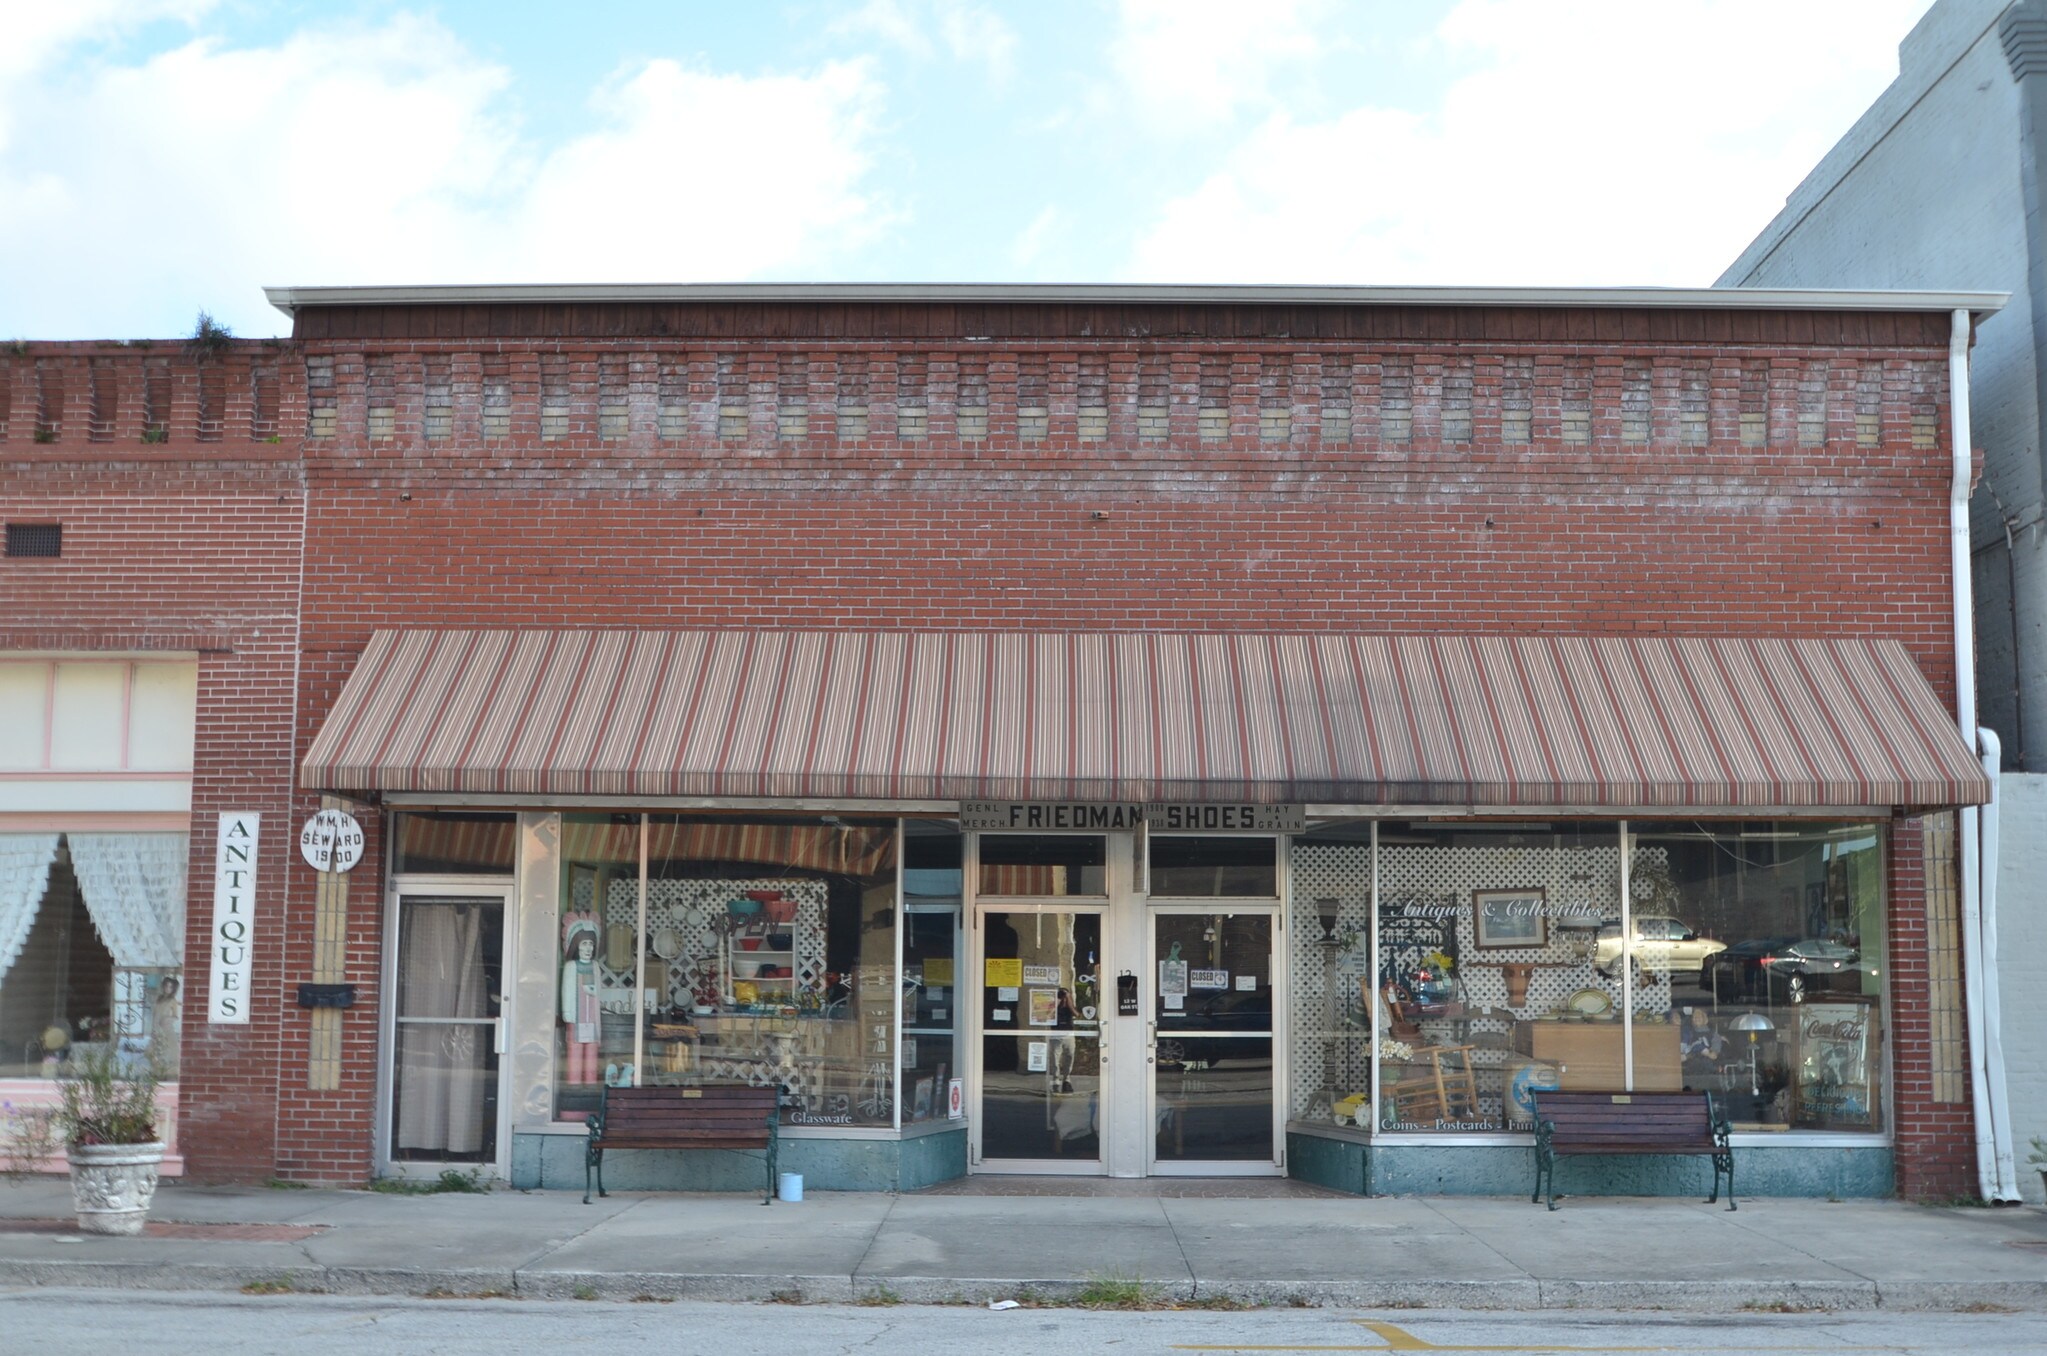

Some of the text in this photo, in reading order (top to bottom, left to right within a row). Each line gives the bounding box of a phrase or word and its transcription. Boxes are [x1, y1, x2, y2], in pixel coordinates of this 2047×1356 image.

[1266, 805, 1289, 814] HAY
[1009, 805, 1254, 829] FRIEDMAN SHOES
[1259, 821, 1300, 829] GRAIN
[302, 832, 361, 846] SEWARD
[315, 850, 352, 863] 1900
[1391, 899, 1603, 922] Antiques & Collectibles
[219, 819, 250, 1018] ANTIQUES
[715, 911, 782, 937] OPEN
[1025, 967, 1047, 977] CLOSED
[1192, 971, 1213, 981] CLOSED
[790, 1111, 853, 1124] Glassware
[1381, 1118, 1418, 1131] Coins
[1435, 1118, 1493, 1131] Postcards
